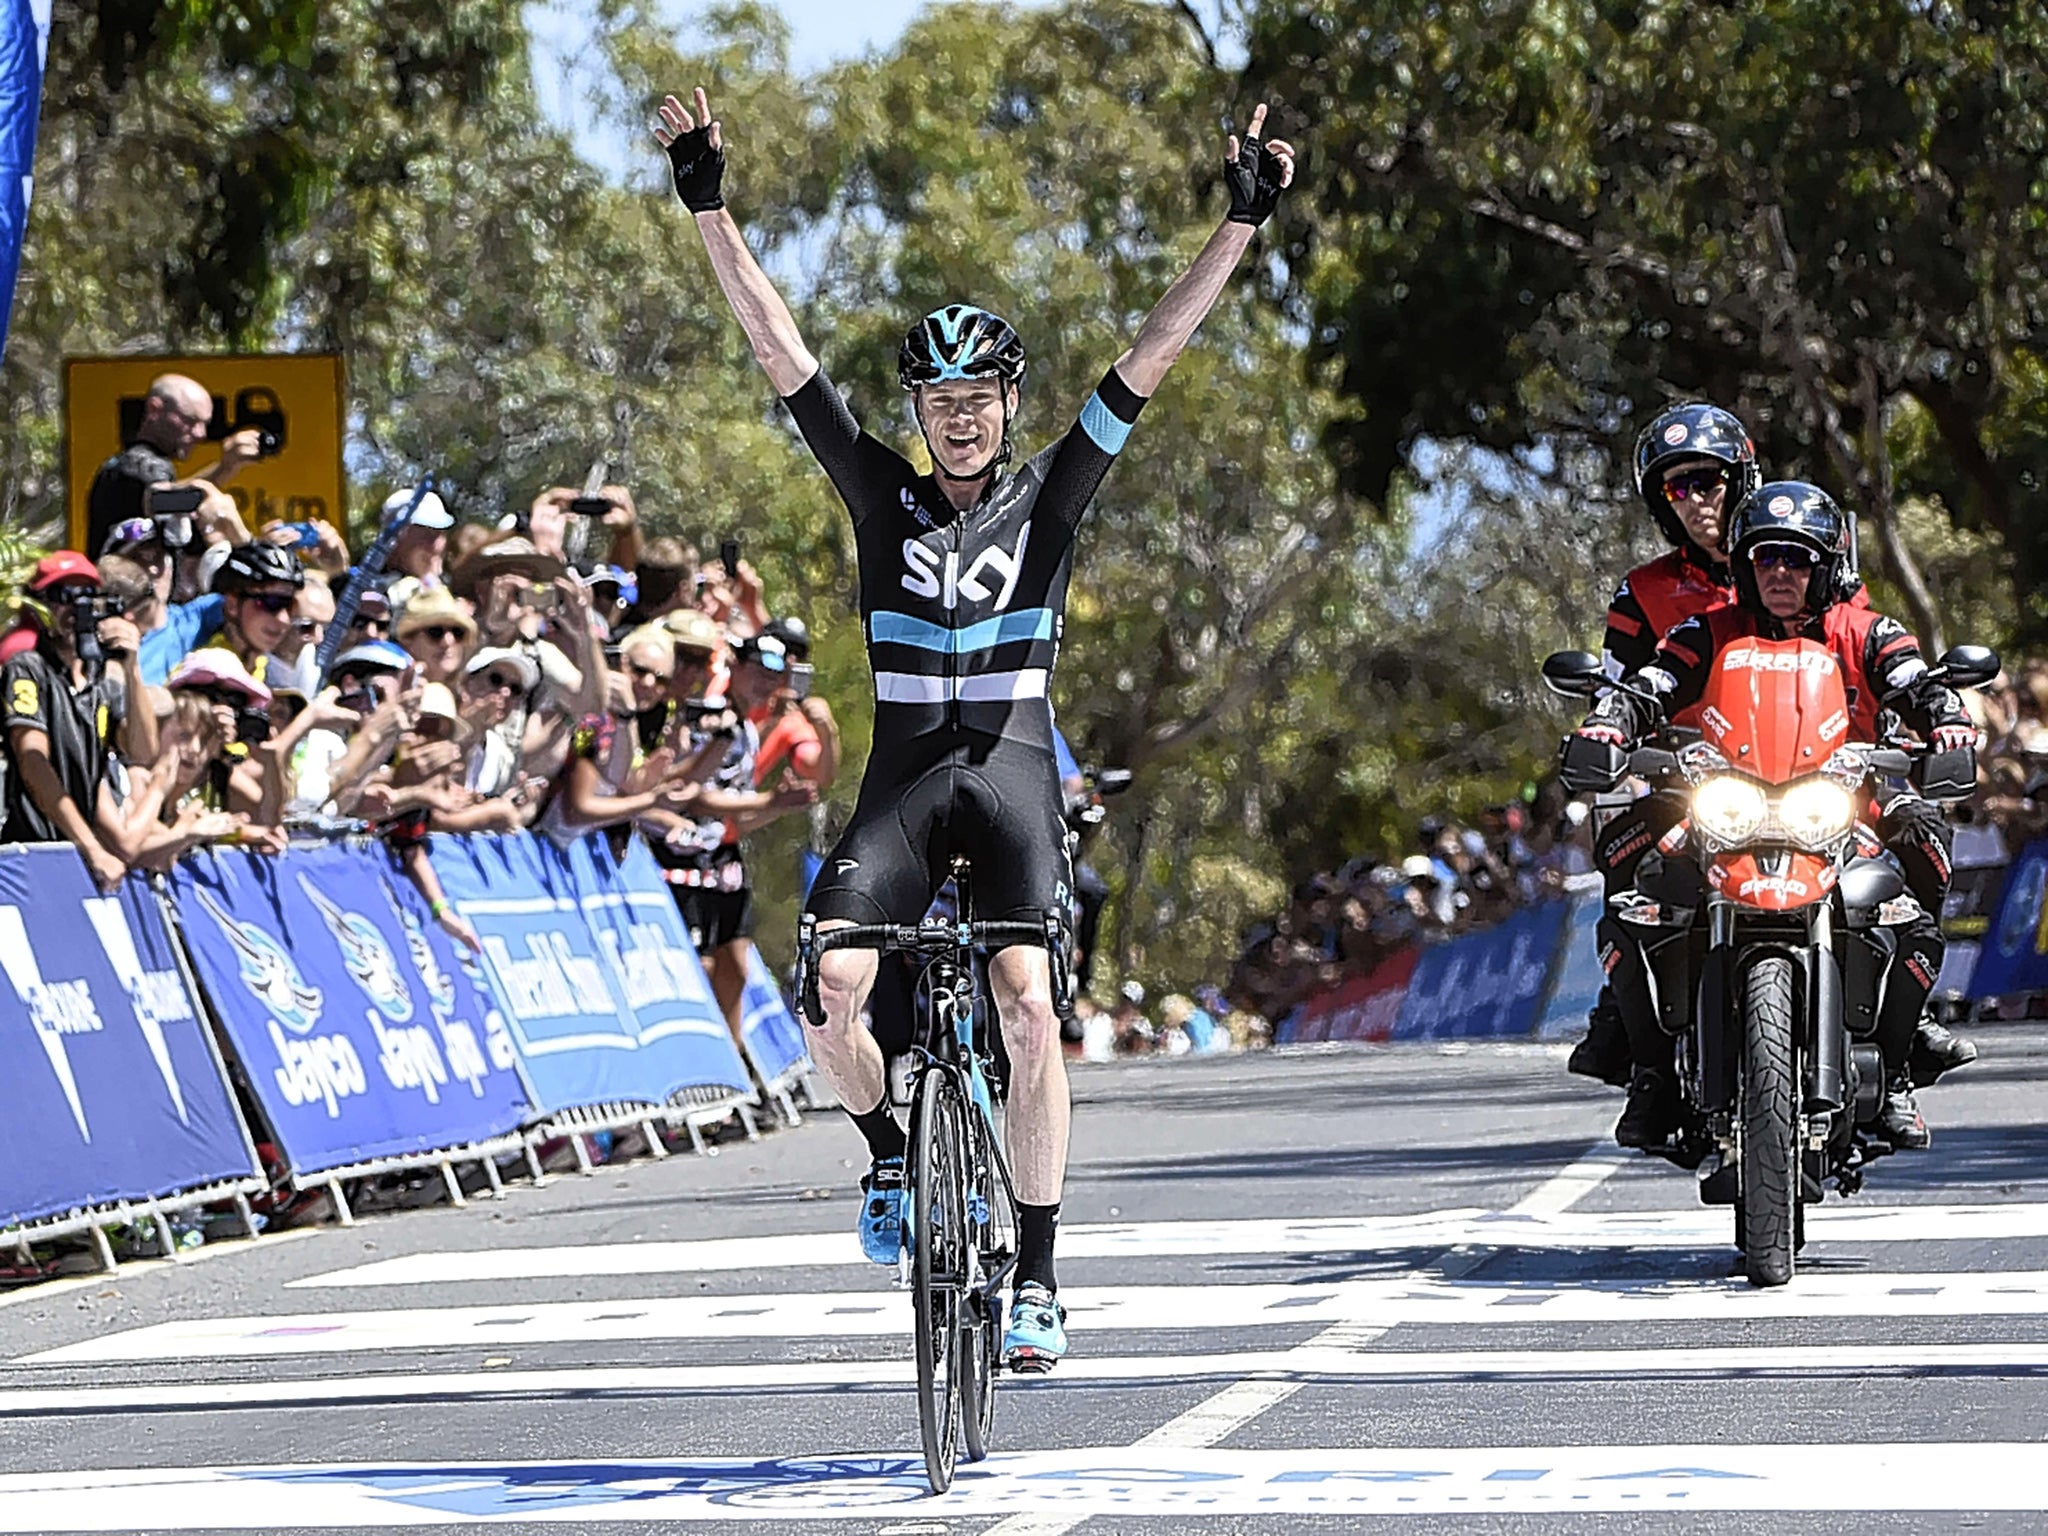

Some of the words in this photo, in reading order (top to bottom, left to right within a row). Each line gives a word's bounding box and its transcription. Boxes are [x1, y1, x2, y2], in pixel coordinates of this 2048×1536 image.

[1722, 648, 1835, 676] SRAM
[1609, 832, 1652, 868] SRAM
[267, 1019, 368, 1119] Jayco
[877, 1169, 905, 1182] SID
